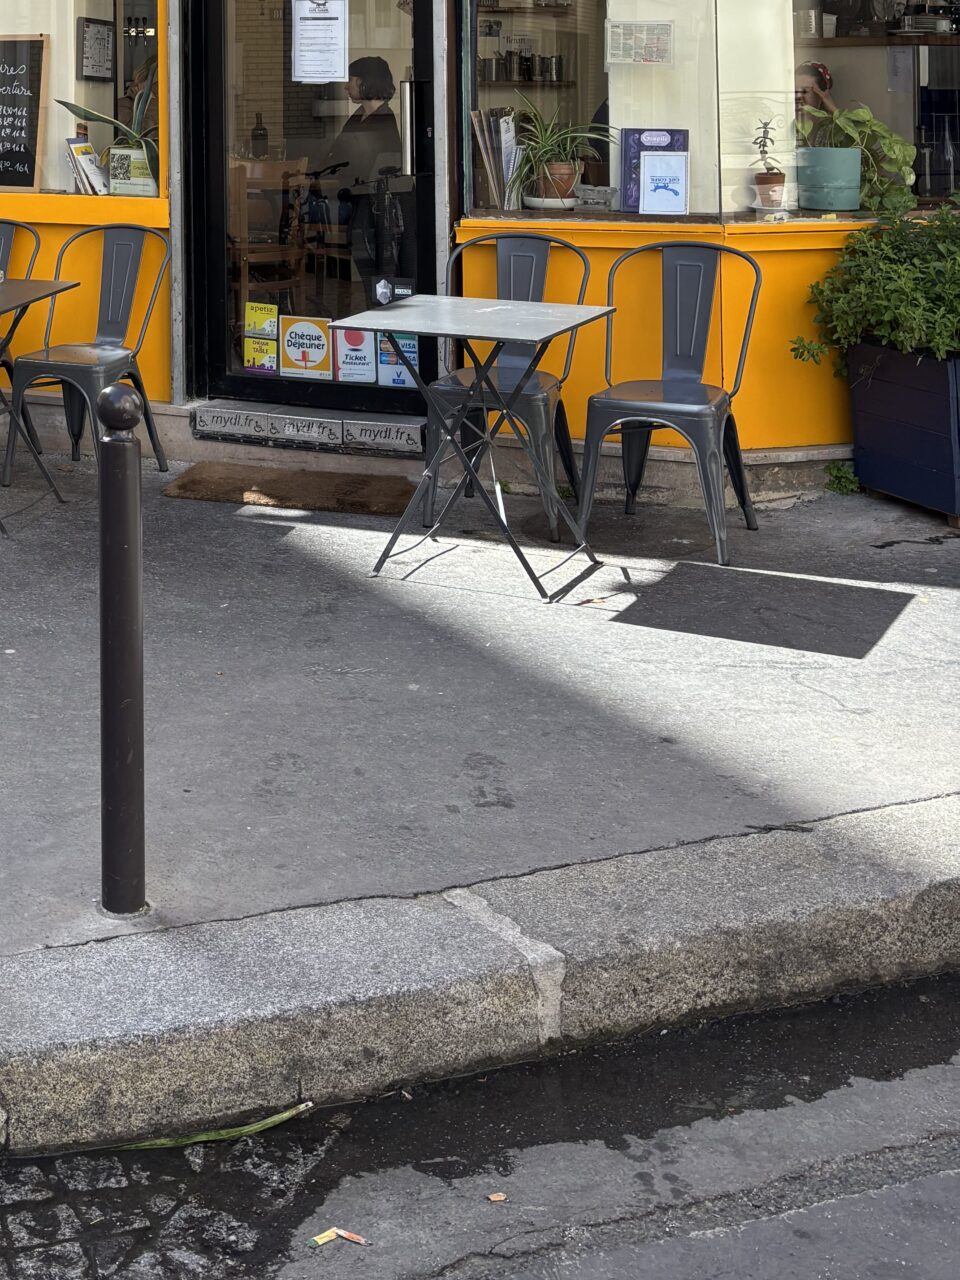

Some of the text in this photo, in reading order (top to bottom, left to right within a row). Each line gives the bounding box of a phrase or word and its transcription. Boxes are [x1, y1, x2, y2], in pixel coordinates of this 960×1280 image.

[289, 331, 322, 342] Chèque
[287, 339, 326, 350] Déjeuner
[210, 414, 253, 428] mydl.fr
[359, 426, 405, 441] mydl.fr
